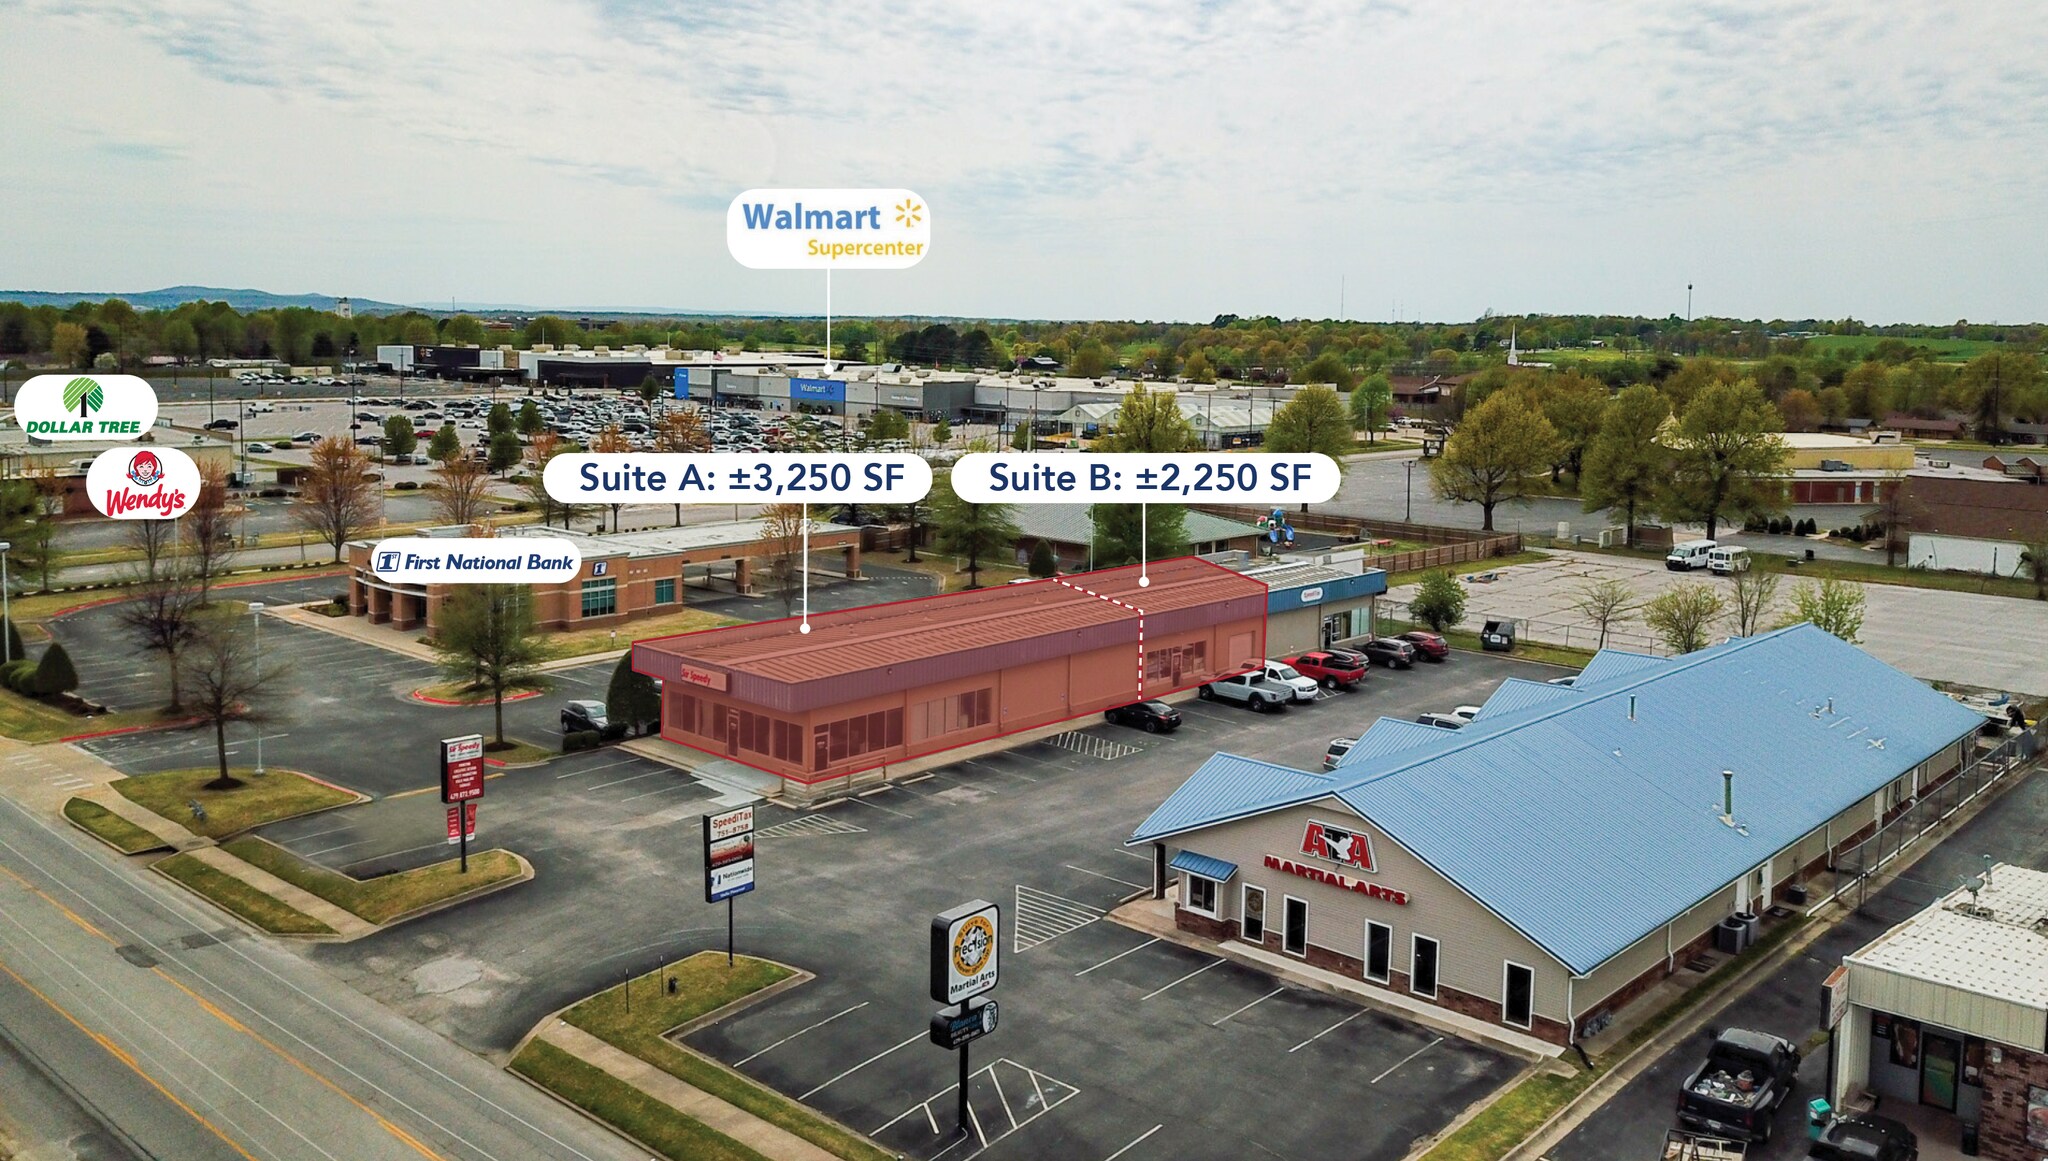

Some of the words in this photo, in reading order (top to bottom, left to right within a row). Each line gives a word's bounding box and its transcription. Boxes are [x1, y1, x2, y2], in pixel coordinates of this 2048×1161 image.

[801, 384, 826, 394] Walmart
[458, 741, 480, 754] Speedy
[712, 811, 752, 830] SpeediTax
[722, 866, 753, 879] Nationwide
[1263, 855, 1353, 892] MARTIAL
[1353, 880, 1410, 906] ARTS
[950, 976, 979, 995] Martial
[979, 970, 995, 984] Arts
